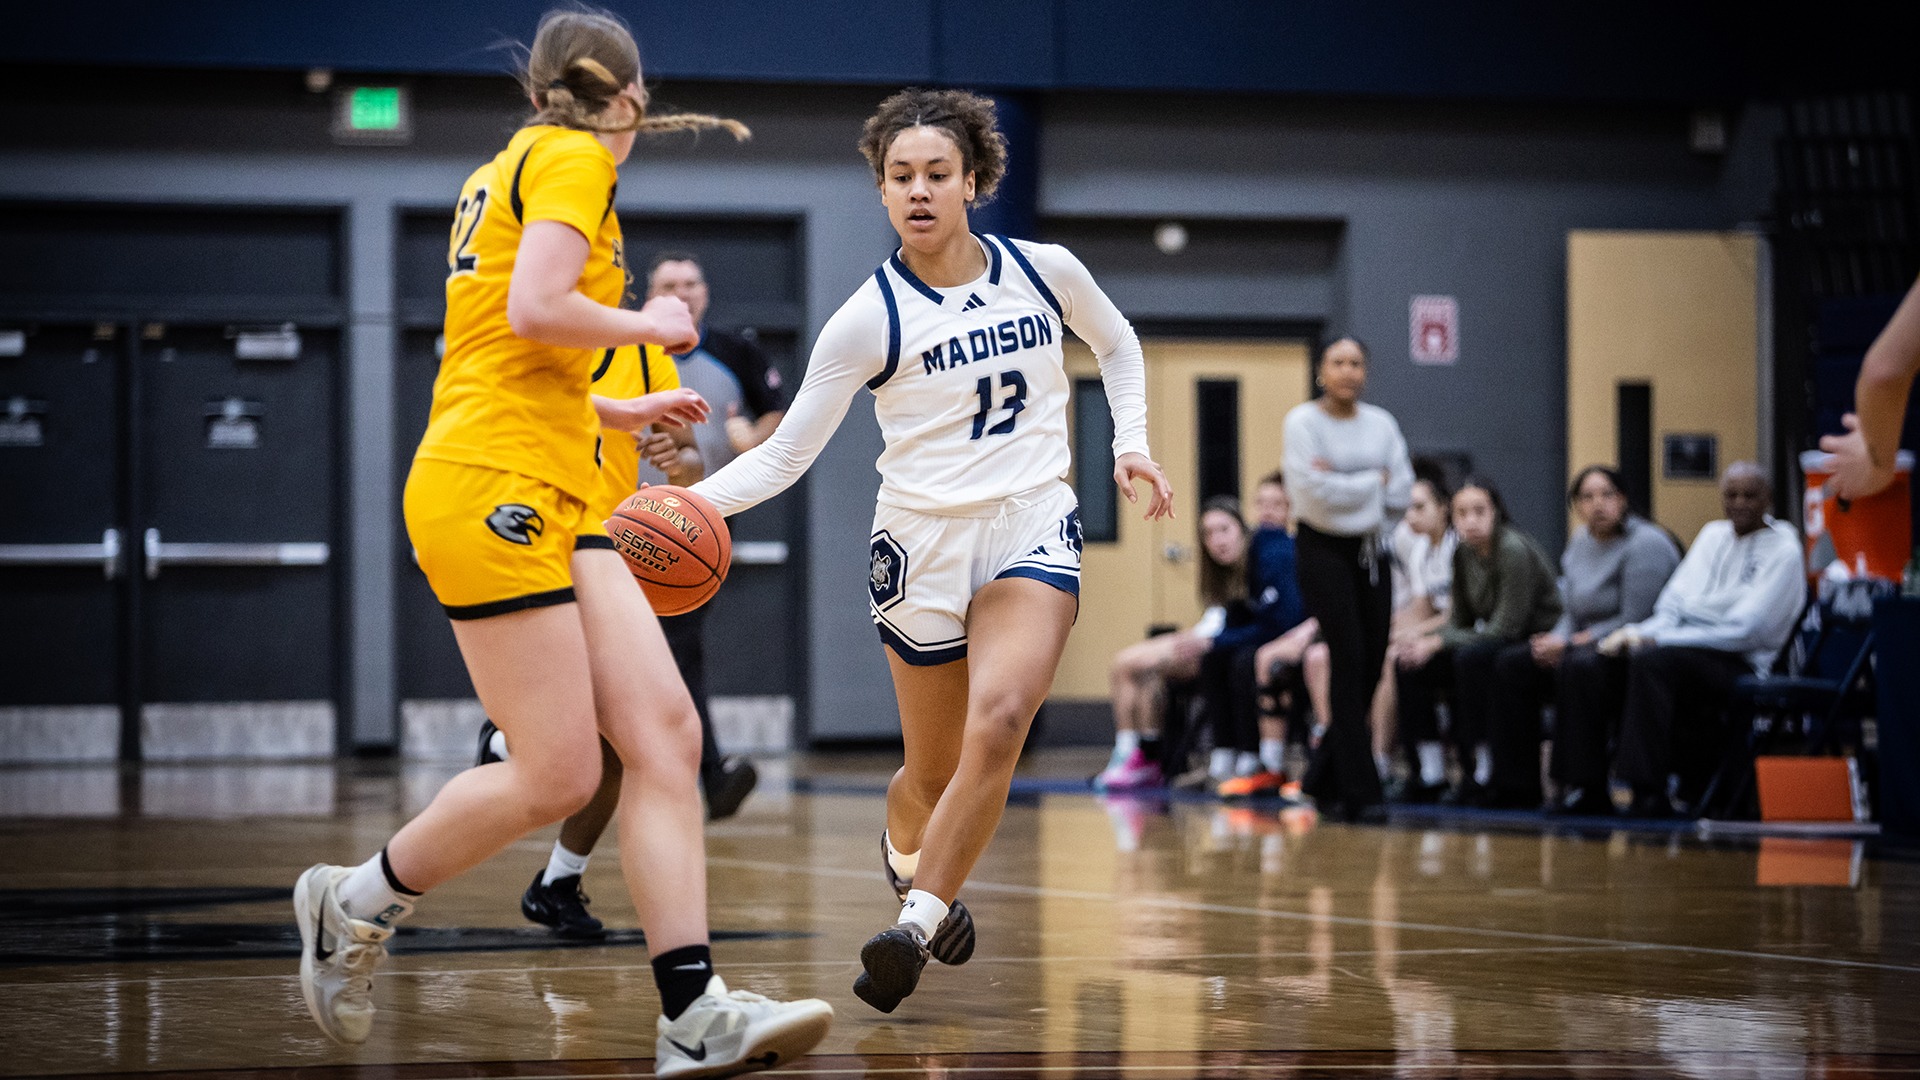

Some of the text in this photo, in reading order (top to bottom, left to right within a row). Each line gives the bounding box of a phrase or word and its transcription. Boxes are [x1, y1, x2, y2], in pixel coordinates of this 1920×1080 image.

[921, 313, 1053, 376] MADISON
[969, 369, 1028, 441] 13
[613, 523, 680, 566] LEGACY
[624, 496, 703, 544] SPALDING
